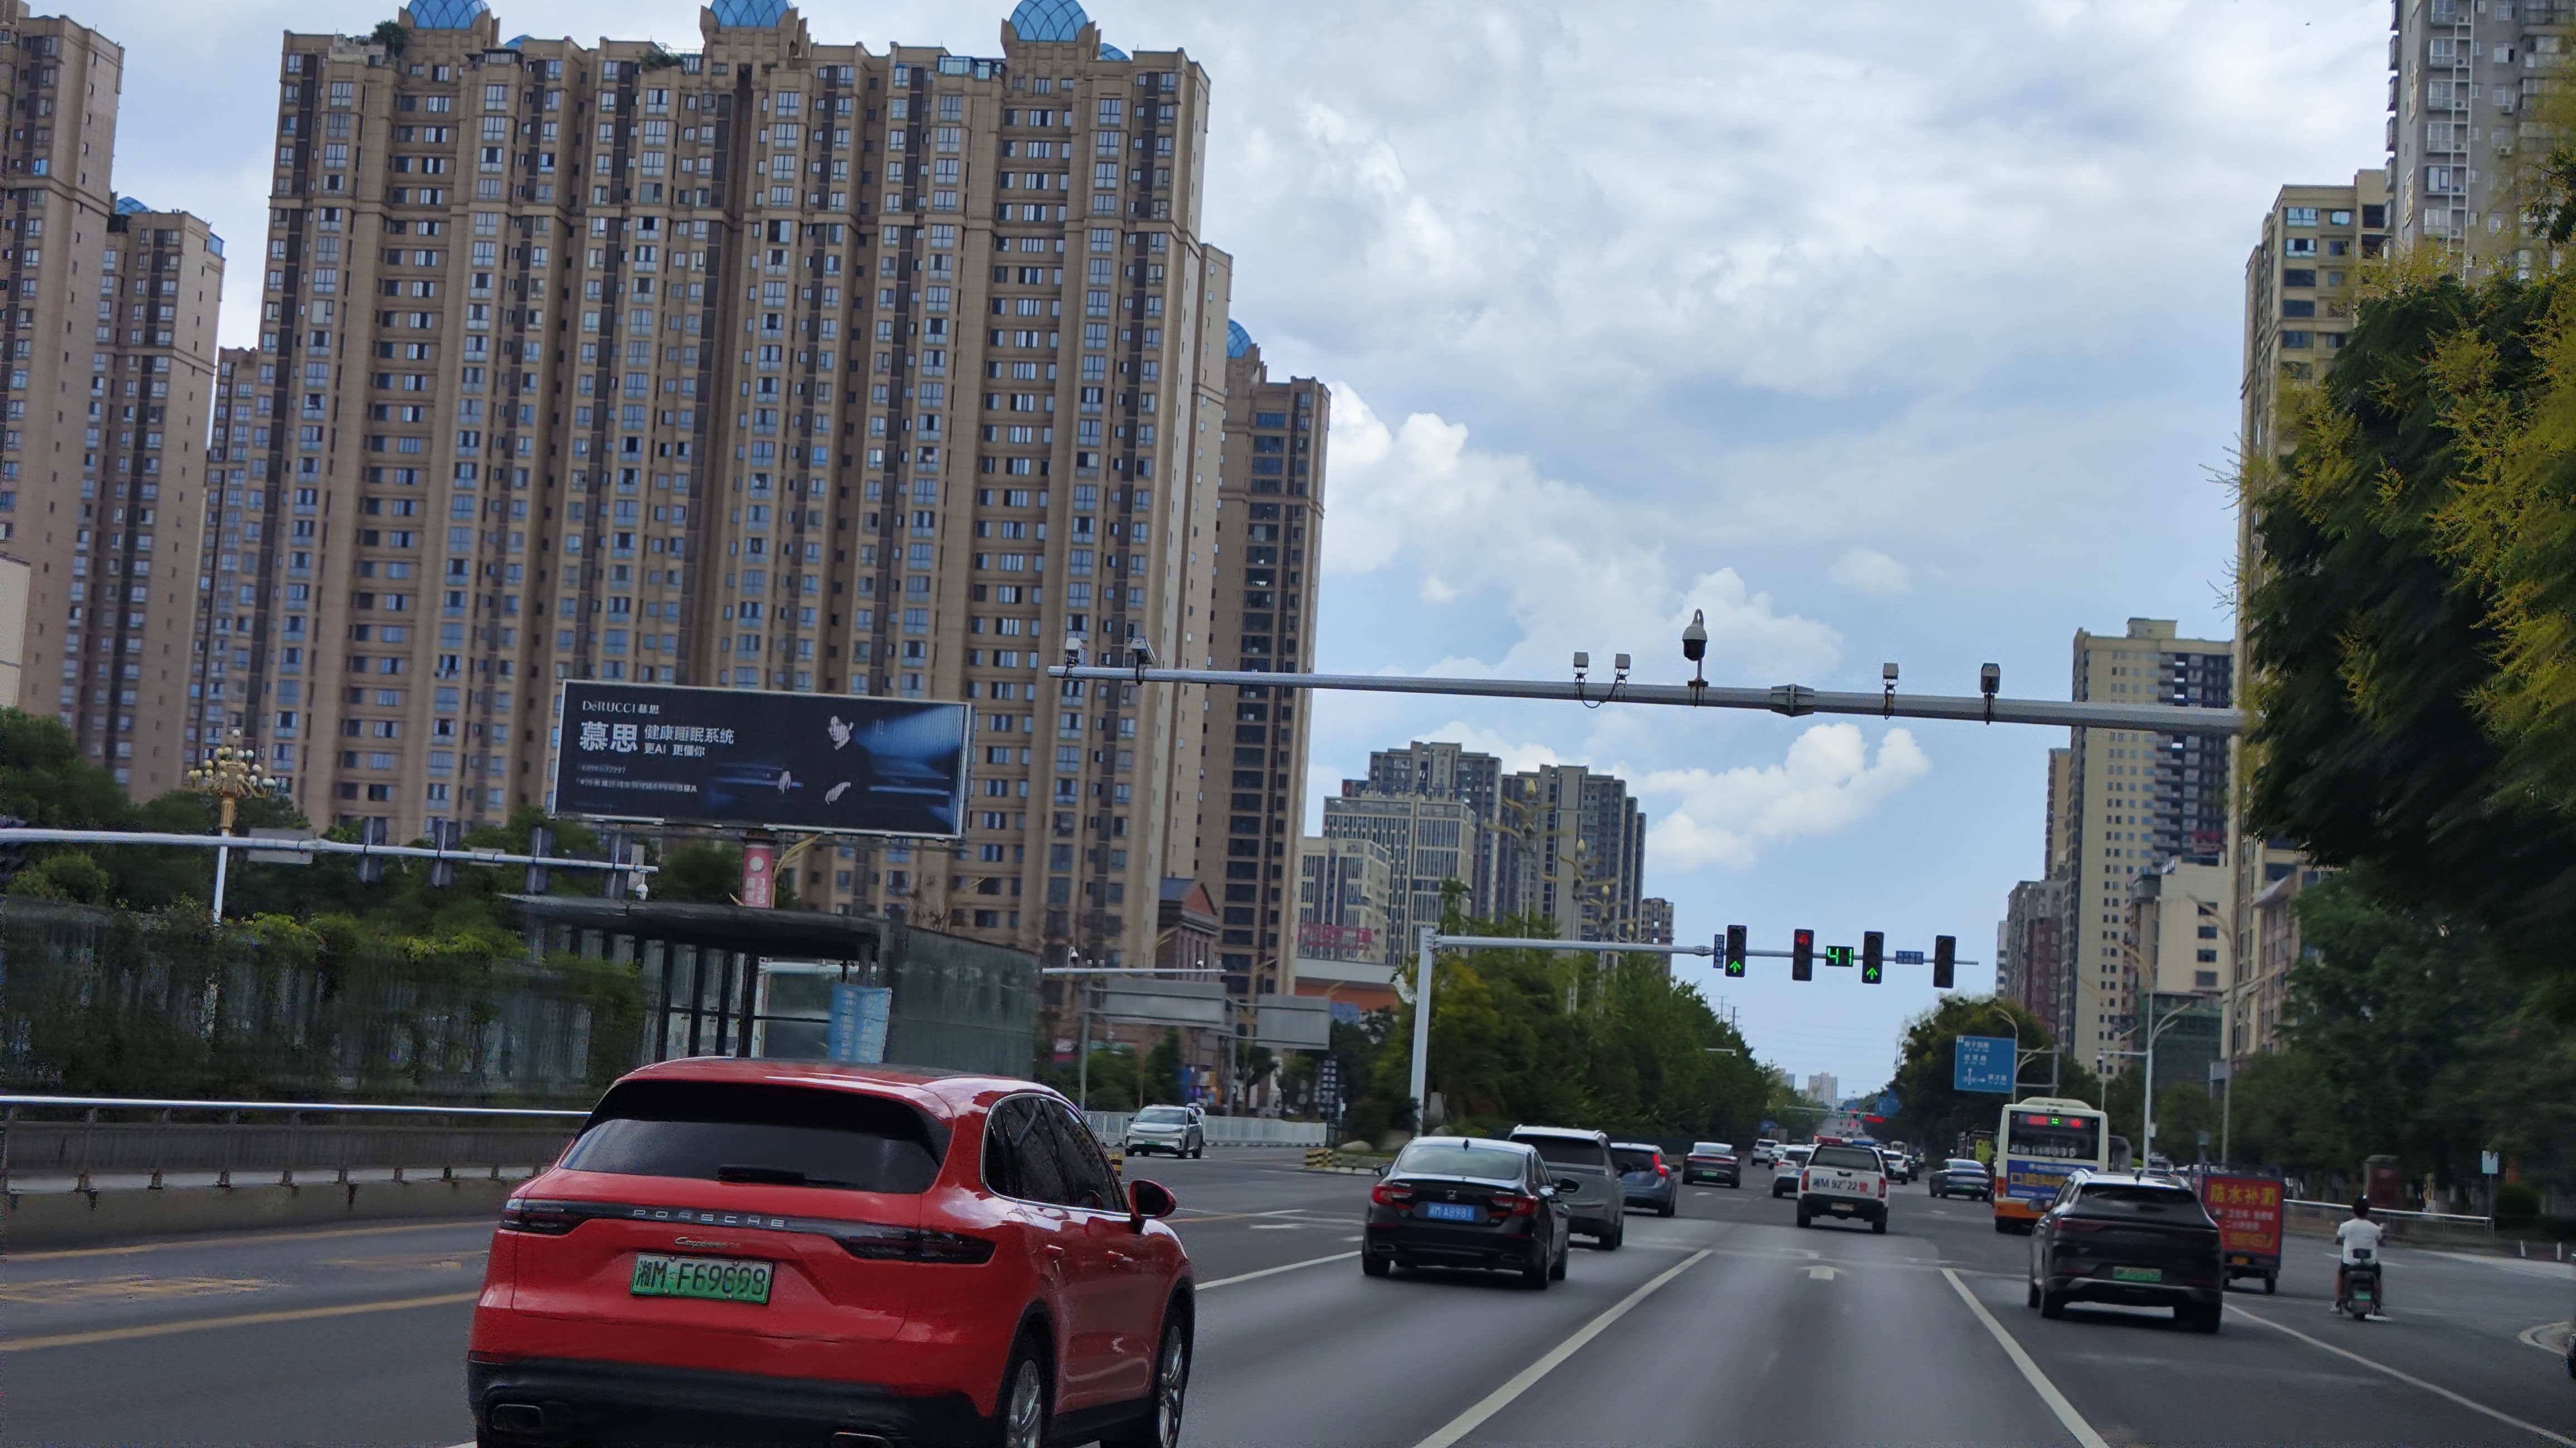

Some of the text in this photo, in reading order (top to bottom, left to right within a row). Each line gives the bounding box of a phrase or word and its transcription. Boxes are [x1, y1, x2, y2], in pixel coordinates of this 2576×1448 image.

[582, 701, 635, 713] DeRUCCI
[579, 721, 638, 752] 慕思
[644, 724, 735, 745] 健康睡眠系统
[1827, 947, 1853, 966] 41
[634, 1209, 785, 1227] PORSCHE
